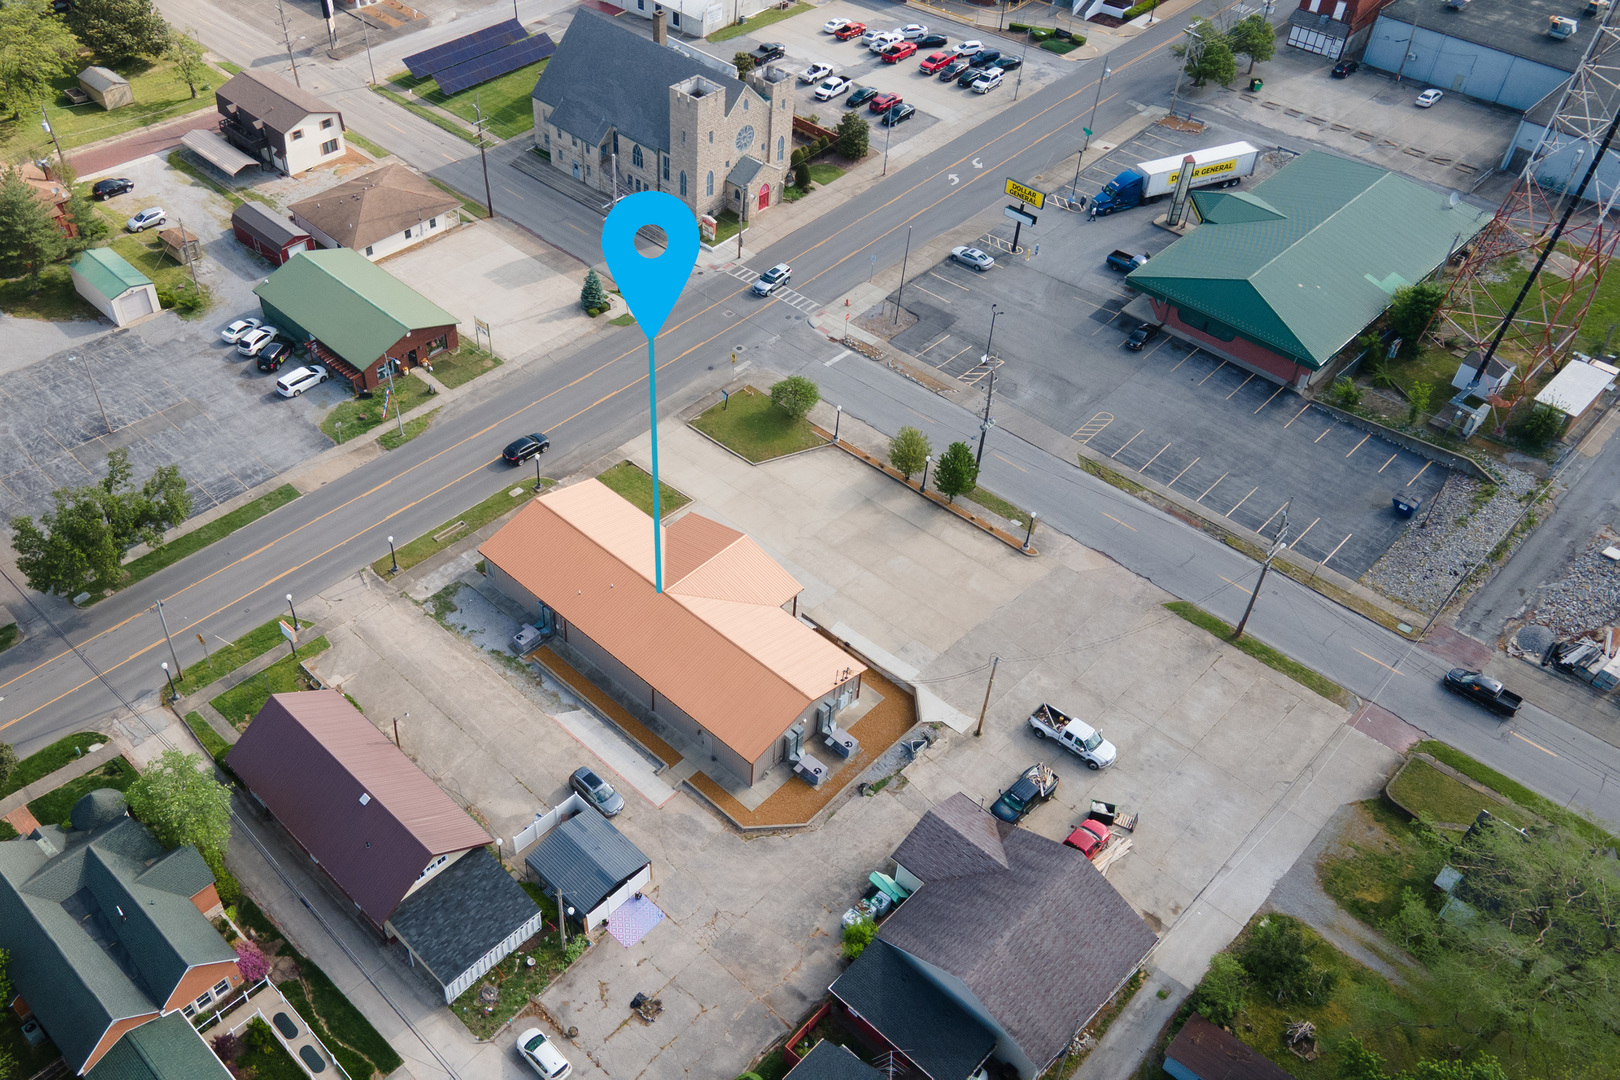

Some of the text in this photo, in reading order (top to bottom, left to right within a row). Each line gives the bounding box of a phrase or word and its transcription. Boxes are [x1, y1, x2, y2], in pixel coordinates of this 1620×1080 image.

[1201, 162, 1233, 175] GENERAL
[1009, 189, 1037, 205] GENERAL
[1012, 183, 1037, 198] DOLLAR
